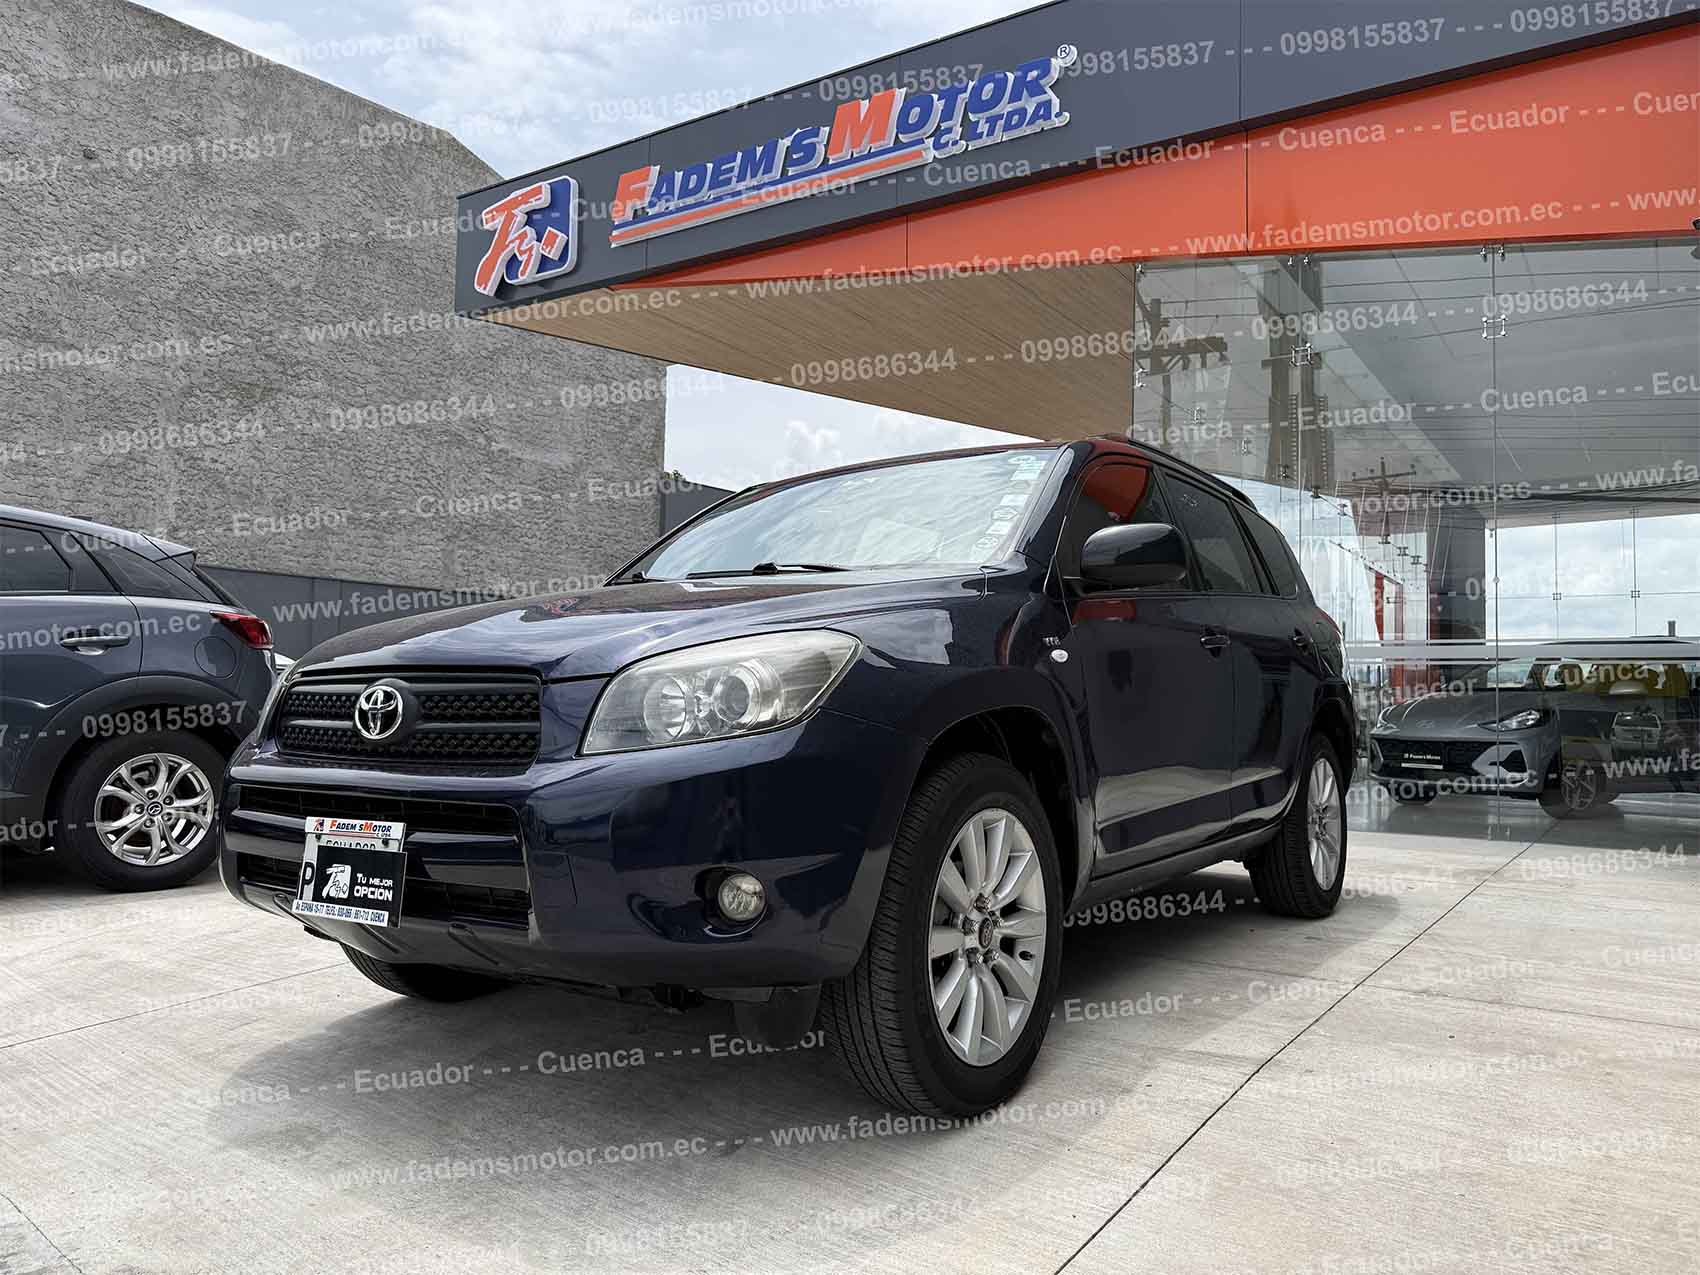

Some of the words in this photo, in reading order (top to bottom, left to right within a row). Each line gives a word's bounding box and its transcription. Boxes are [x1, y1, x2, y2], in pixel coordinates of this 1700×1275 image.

[827, 56, 1060, 160] MOTOR
[967, 99, 1070, 151] LTDA.
[369, 877, 393, 888] MEJOR
